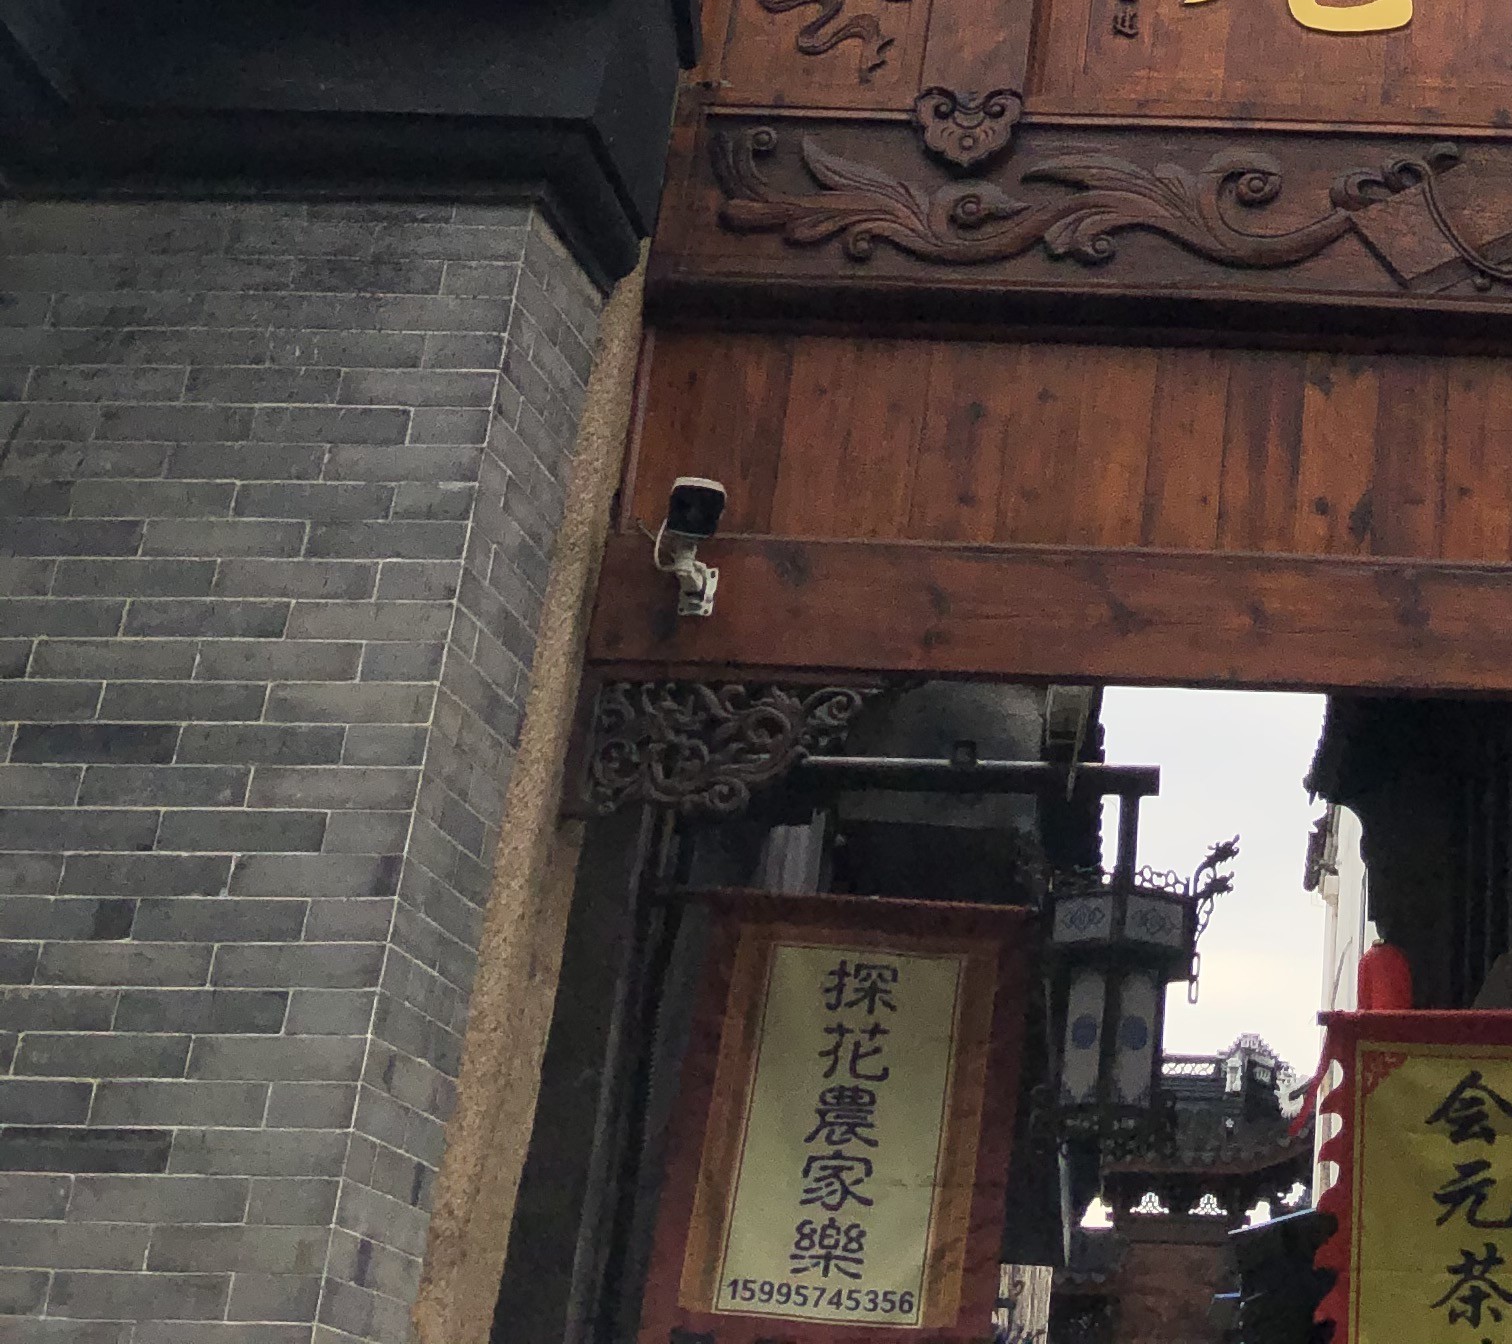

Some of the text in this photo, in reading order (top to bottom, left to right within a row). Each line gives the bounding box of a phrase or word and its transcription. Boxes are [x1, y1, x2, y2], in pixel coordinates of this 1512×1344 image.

[789, 959, 899, 1279] 探花農家樂
[727, 1277, 915, 1315] 15995745356
